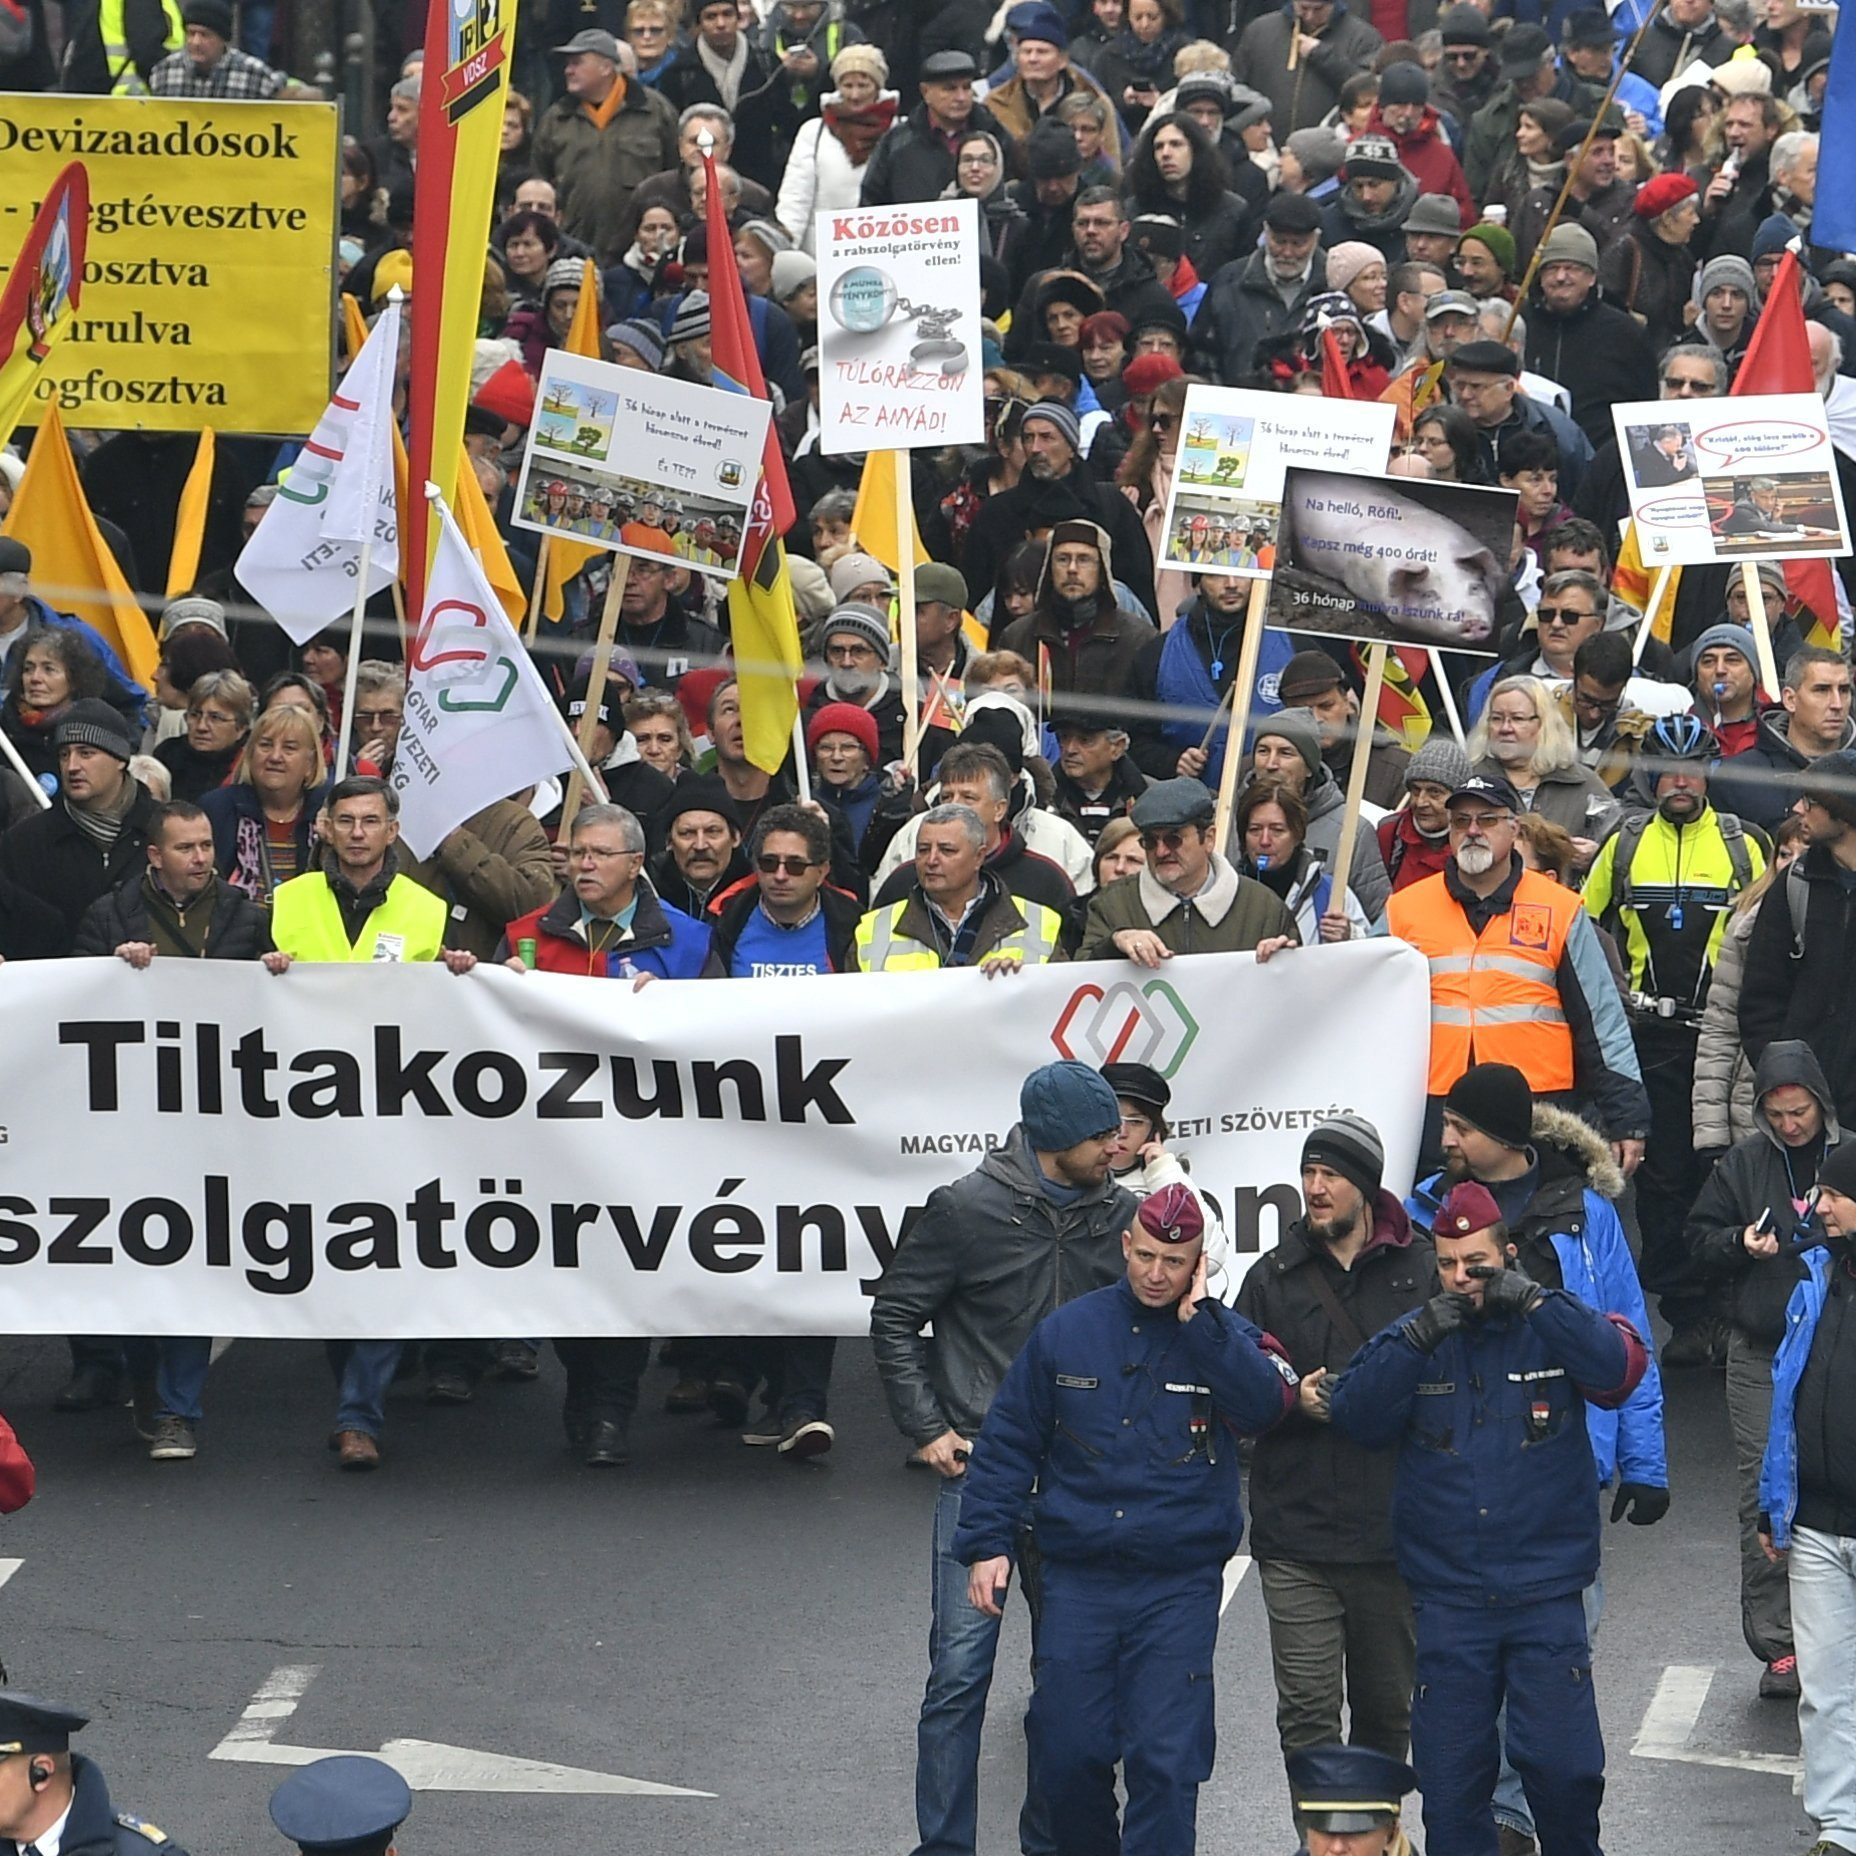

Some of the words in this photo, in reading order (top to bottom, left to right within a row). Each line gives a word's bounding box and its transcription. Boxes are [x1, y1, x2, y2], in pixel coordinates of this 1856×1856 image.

[463, 52, 487, 86] VDSZ
[832, 213, 960, 241] Közösen
[844, 239, 961, 258] rabszolgatörvény
[925, 254, 961, 266] ellen!
[82, 258, 209, 287] osztva
[34, 369, 227, 409] ogfosztva
[839, 402, 870, 424] AZ
[875, 404, 946, 433] ANYÁD!
[1306, 498, 1324, 511] Na
[1328, 500, 1364, 518] helló,
[1300, 536, 1340, 554] Kapsz
[1344, 542, 1373, 559] még
[1377, 548, 1401, 559] 400
[1406, 547, 1437, 562] órát!
[1292, 593, 1309, 605] 36
[1313, 592, 1355, 612] hónap
[1403, 605, 1444, 620] iszunk
[1447, 608, 1465, 622] rá!
[751, 963, 817, 978] TISZTES
[59, 1020, 855, 1124] Tiltakozunk
[901, 1133, 1001, 1155] MAGYAR
